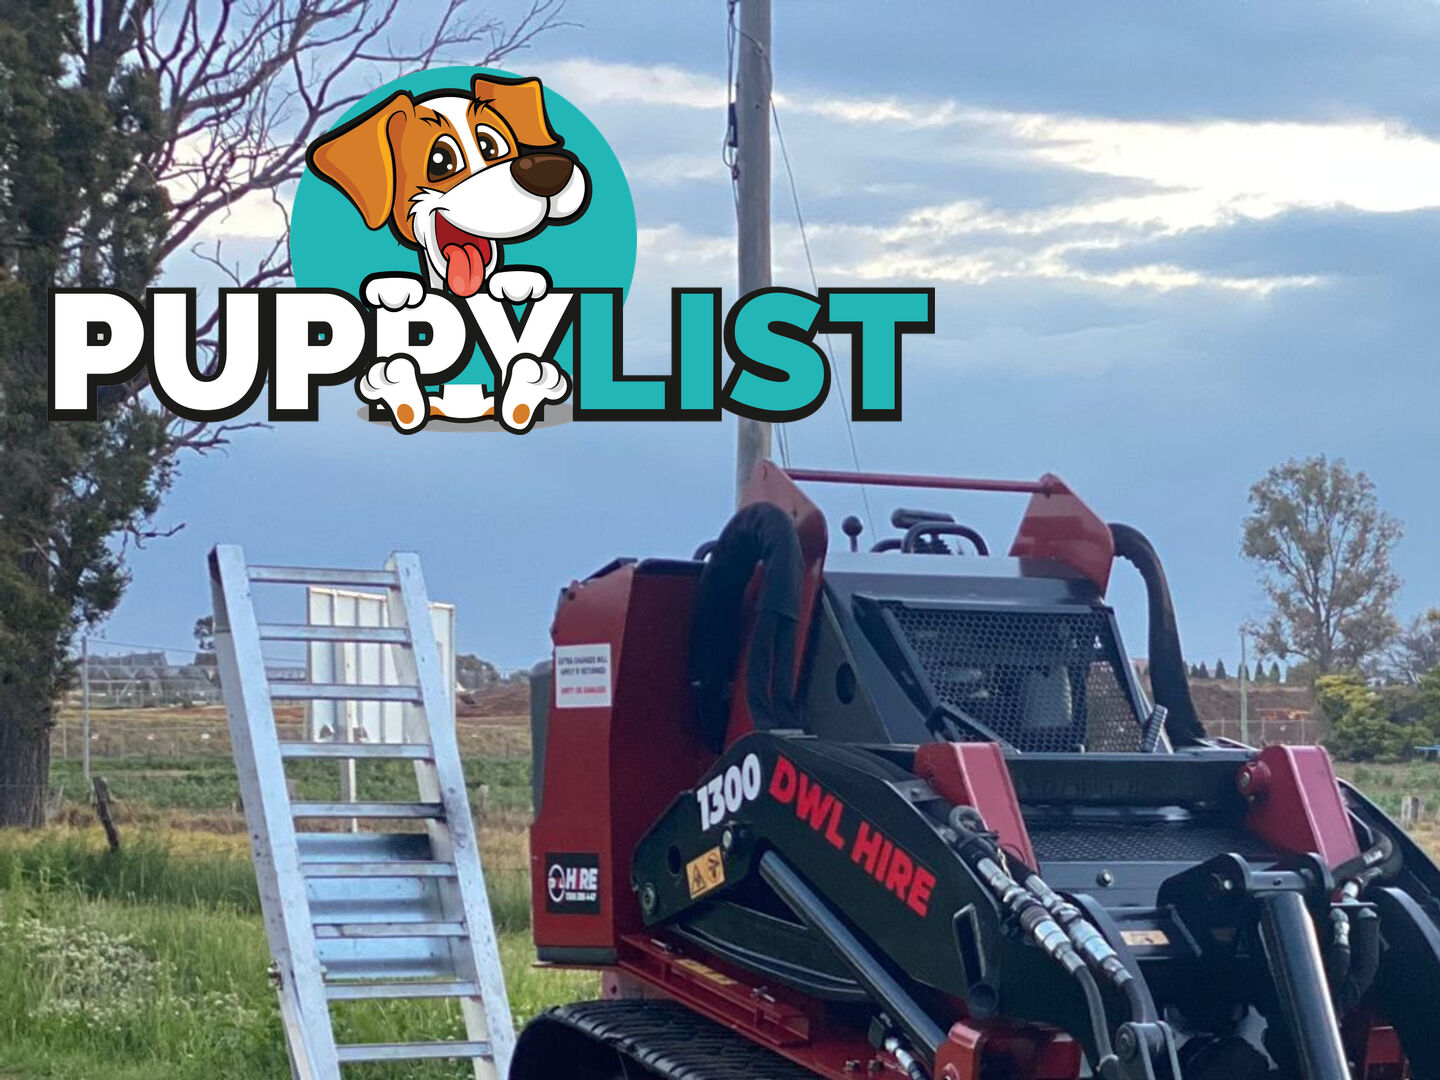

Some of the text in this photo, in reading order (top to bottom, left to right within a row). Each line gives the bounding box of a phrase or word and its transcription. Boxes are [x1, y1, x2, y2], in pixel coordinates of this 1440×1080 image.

[566, 867, 598, 890] HIRE
[697, 753, 936, 918] 1300 DWL HIRE
